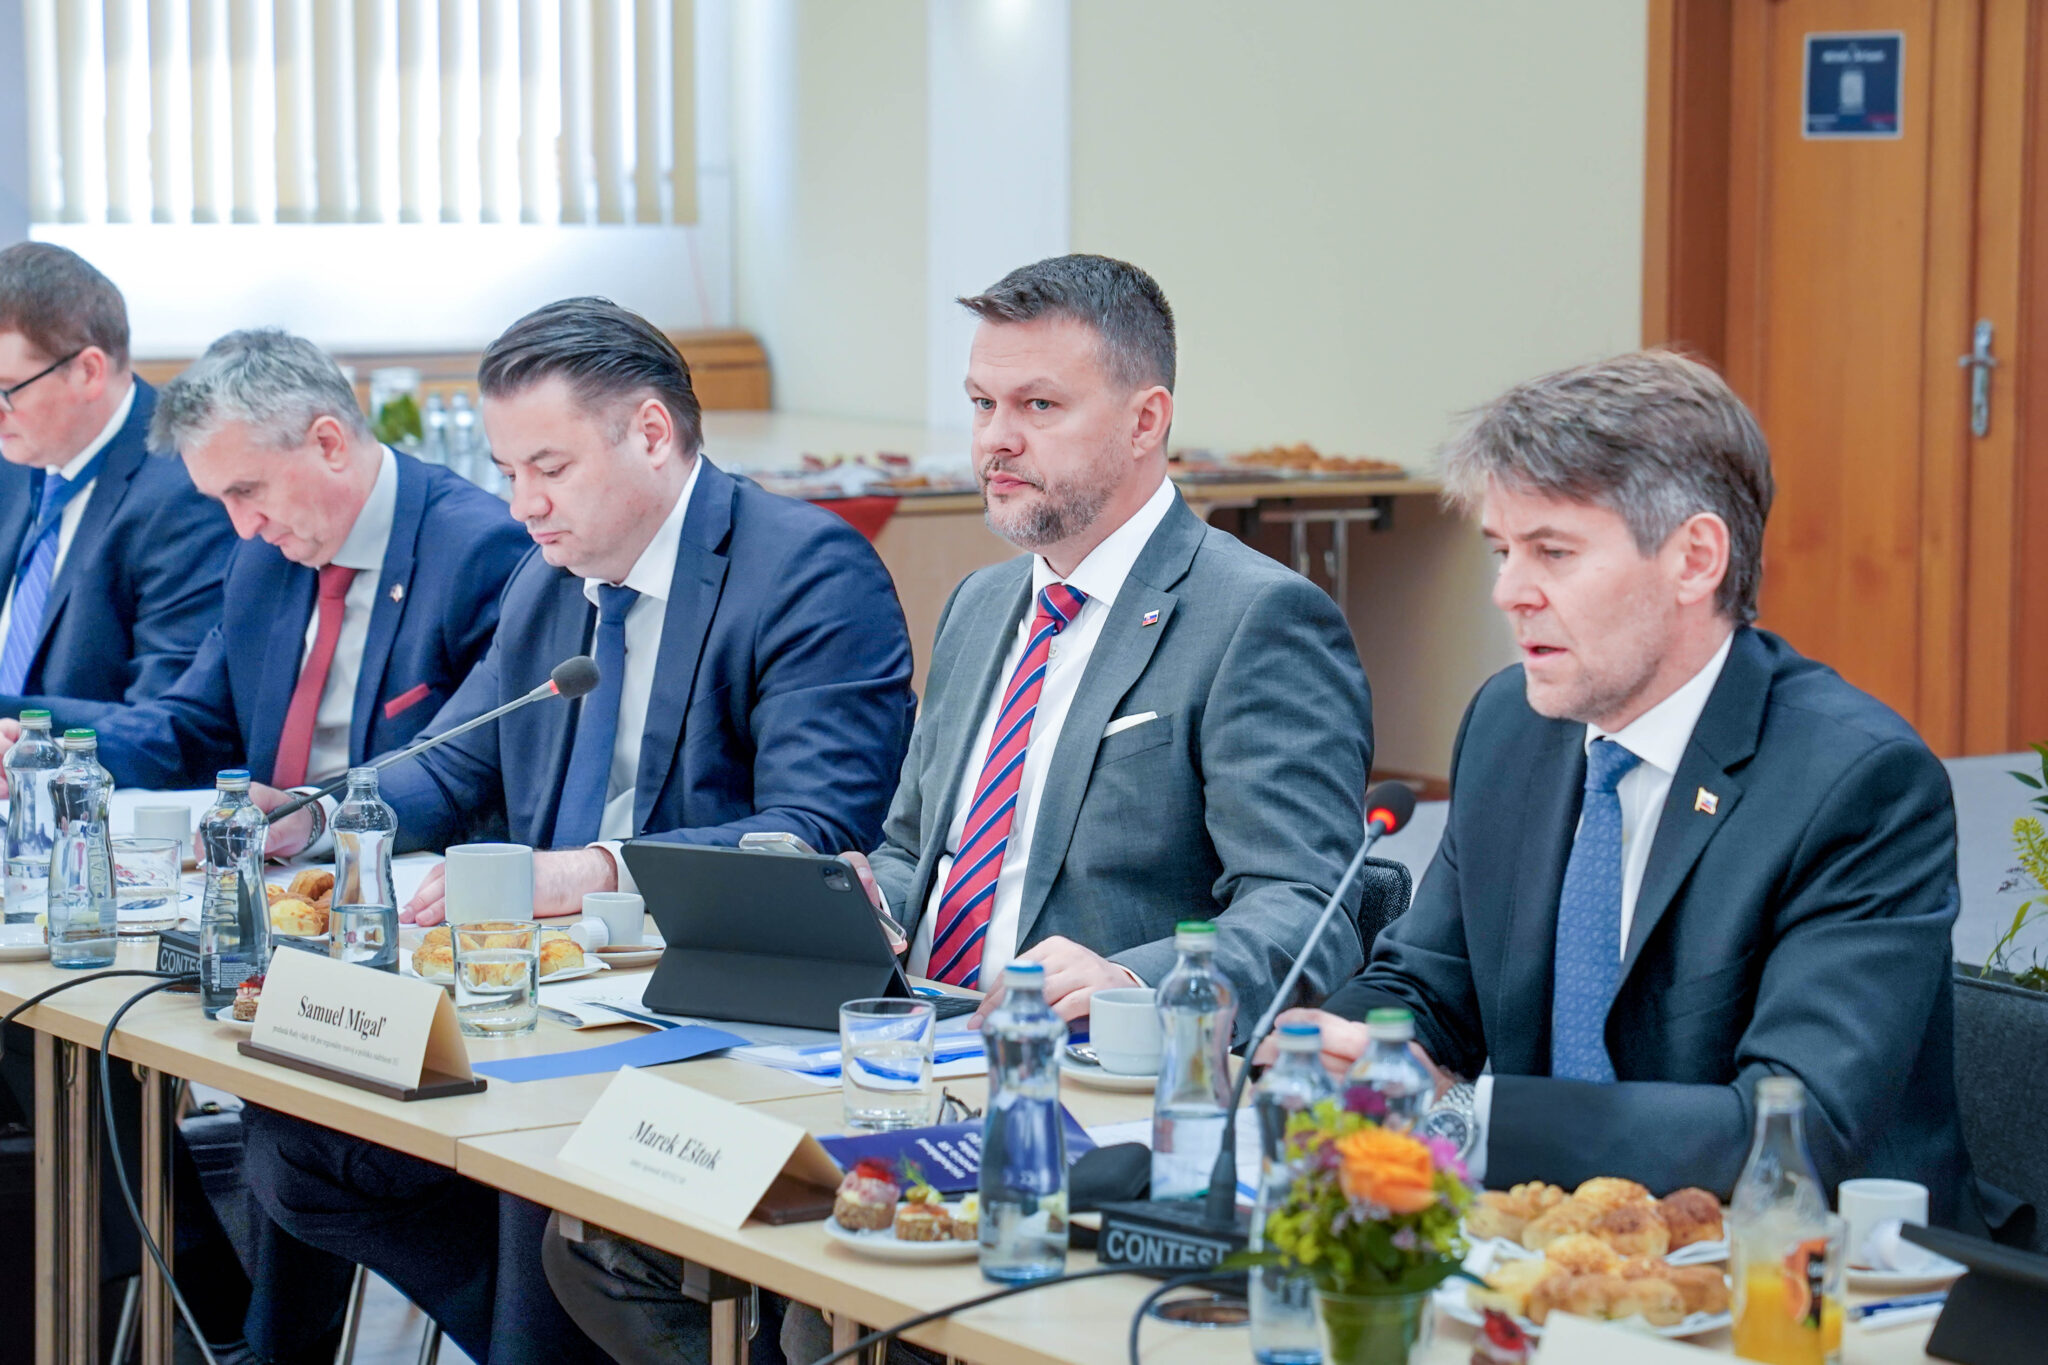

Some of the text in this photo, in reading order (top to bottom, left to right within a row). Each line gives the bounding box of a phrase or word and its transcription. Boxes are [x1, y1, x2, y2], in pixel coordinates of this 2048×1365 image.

[297, 995, 345, 1027] Samuel
[629, 1120, 680, 1155] Marek
[678, 1138, 721, 1171] Eštok
[1106, 1229, 1233, 1266] CONTEST
